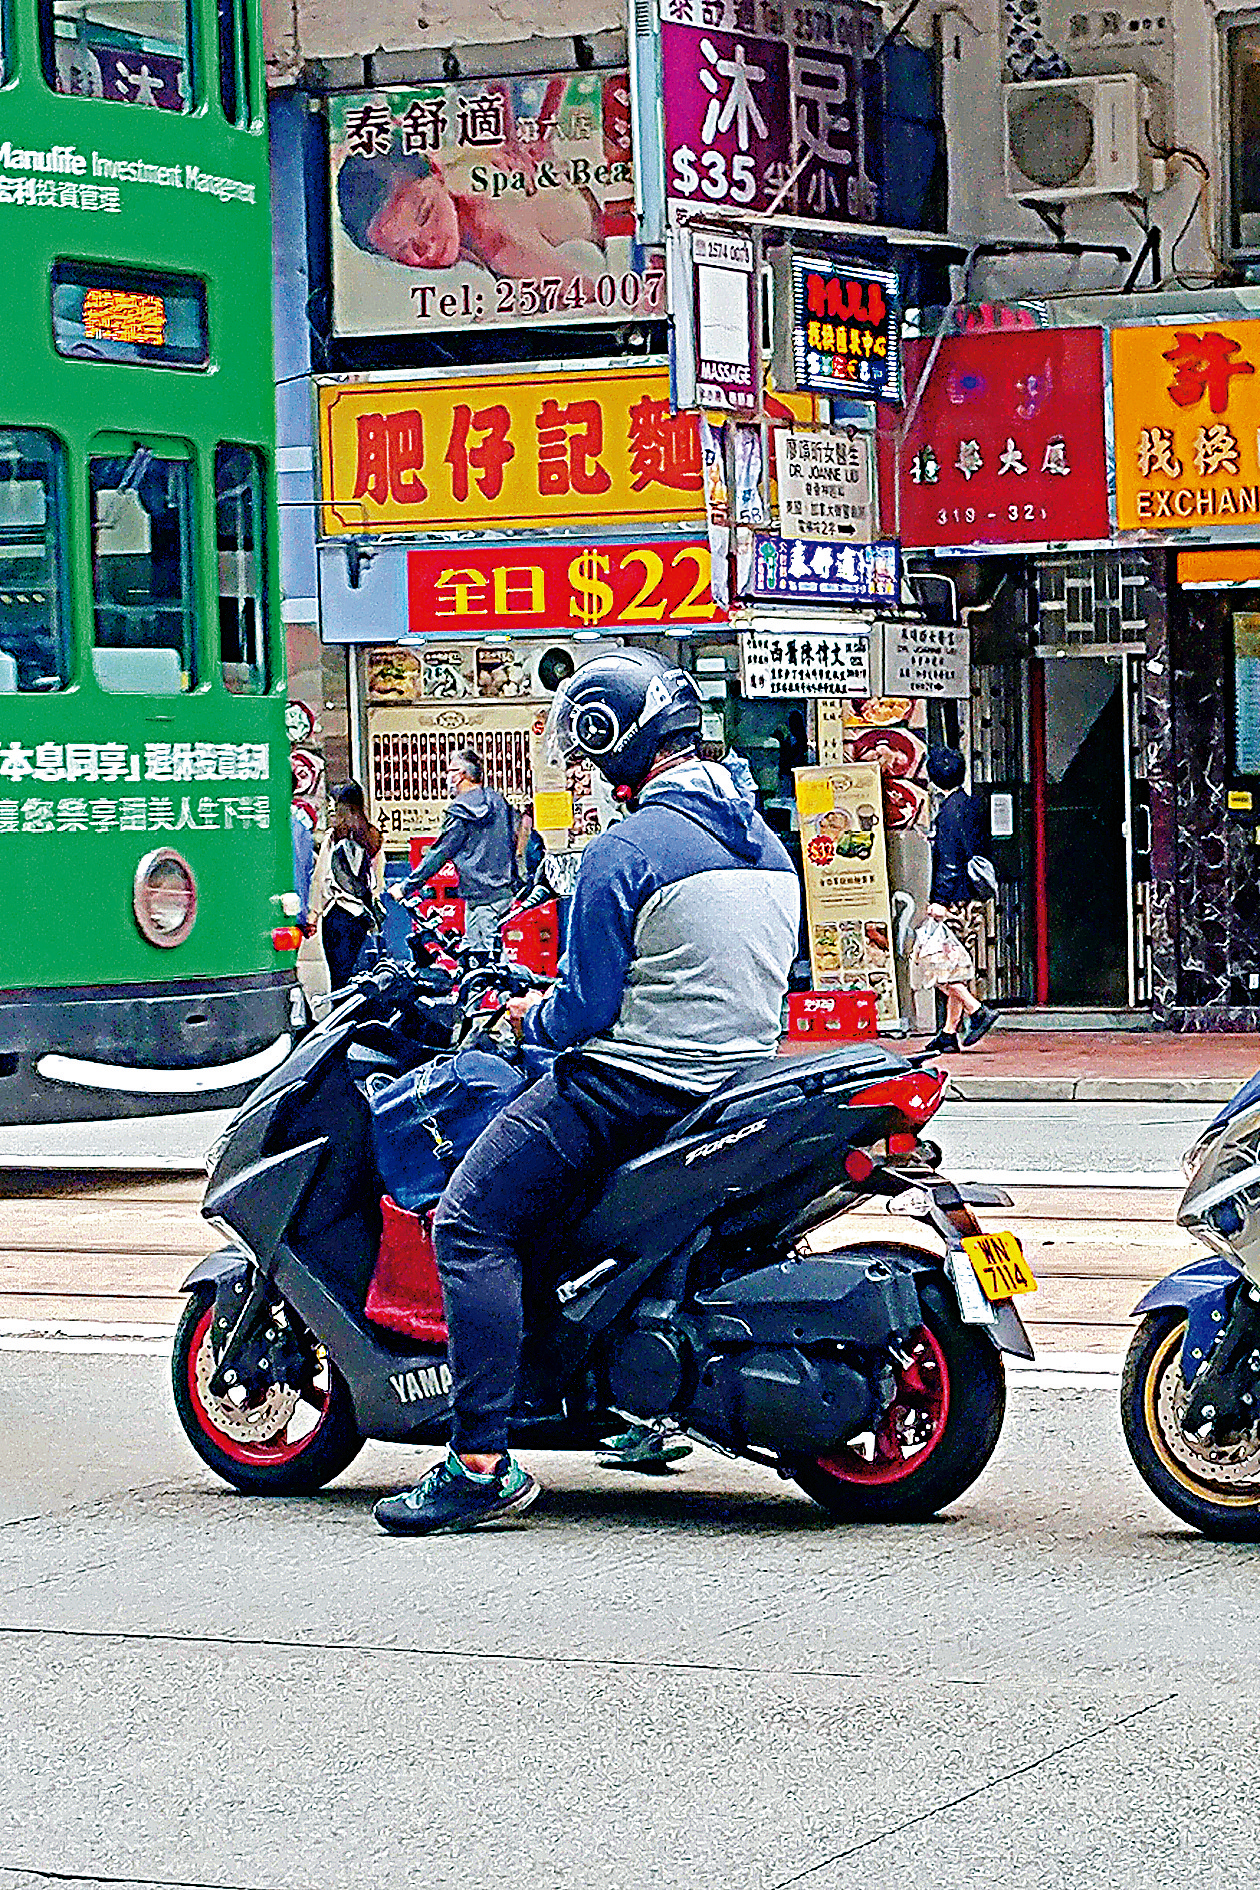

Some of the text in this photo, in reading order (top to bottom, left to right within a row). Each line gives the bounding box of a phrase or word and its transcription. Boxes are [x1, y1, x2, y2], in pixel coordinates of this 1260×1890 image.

[344, 95, 508, 158] 泰舒適
[92, 150, 184, 188] Investment
[470, 165, 526, 197] Spa
[537, 160, 562, 188] &
[672, 144, 756, 202] $35
[411, 284, 484, 319] Tel:
[496, 276, 585, 315] 2574
[700, 361, 752, 386] MASSAGE
[353, 394, 705, 505] 肥仔記麵
[936, 507, 976, 526] 319
[434, 547, 717, 626] 全日 $22
[982, 1262, 1028, 1293] 7114
